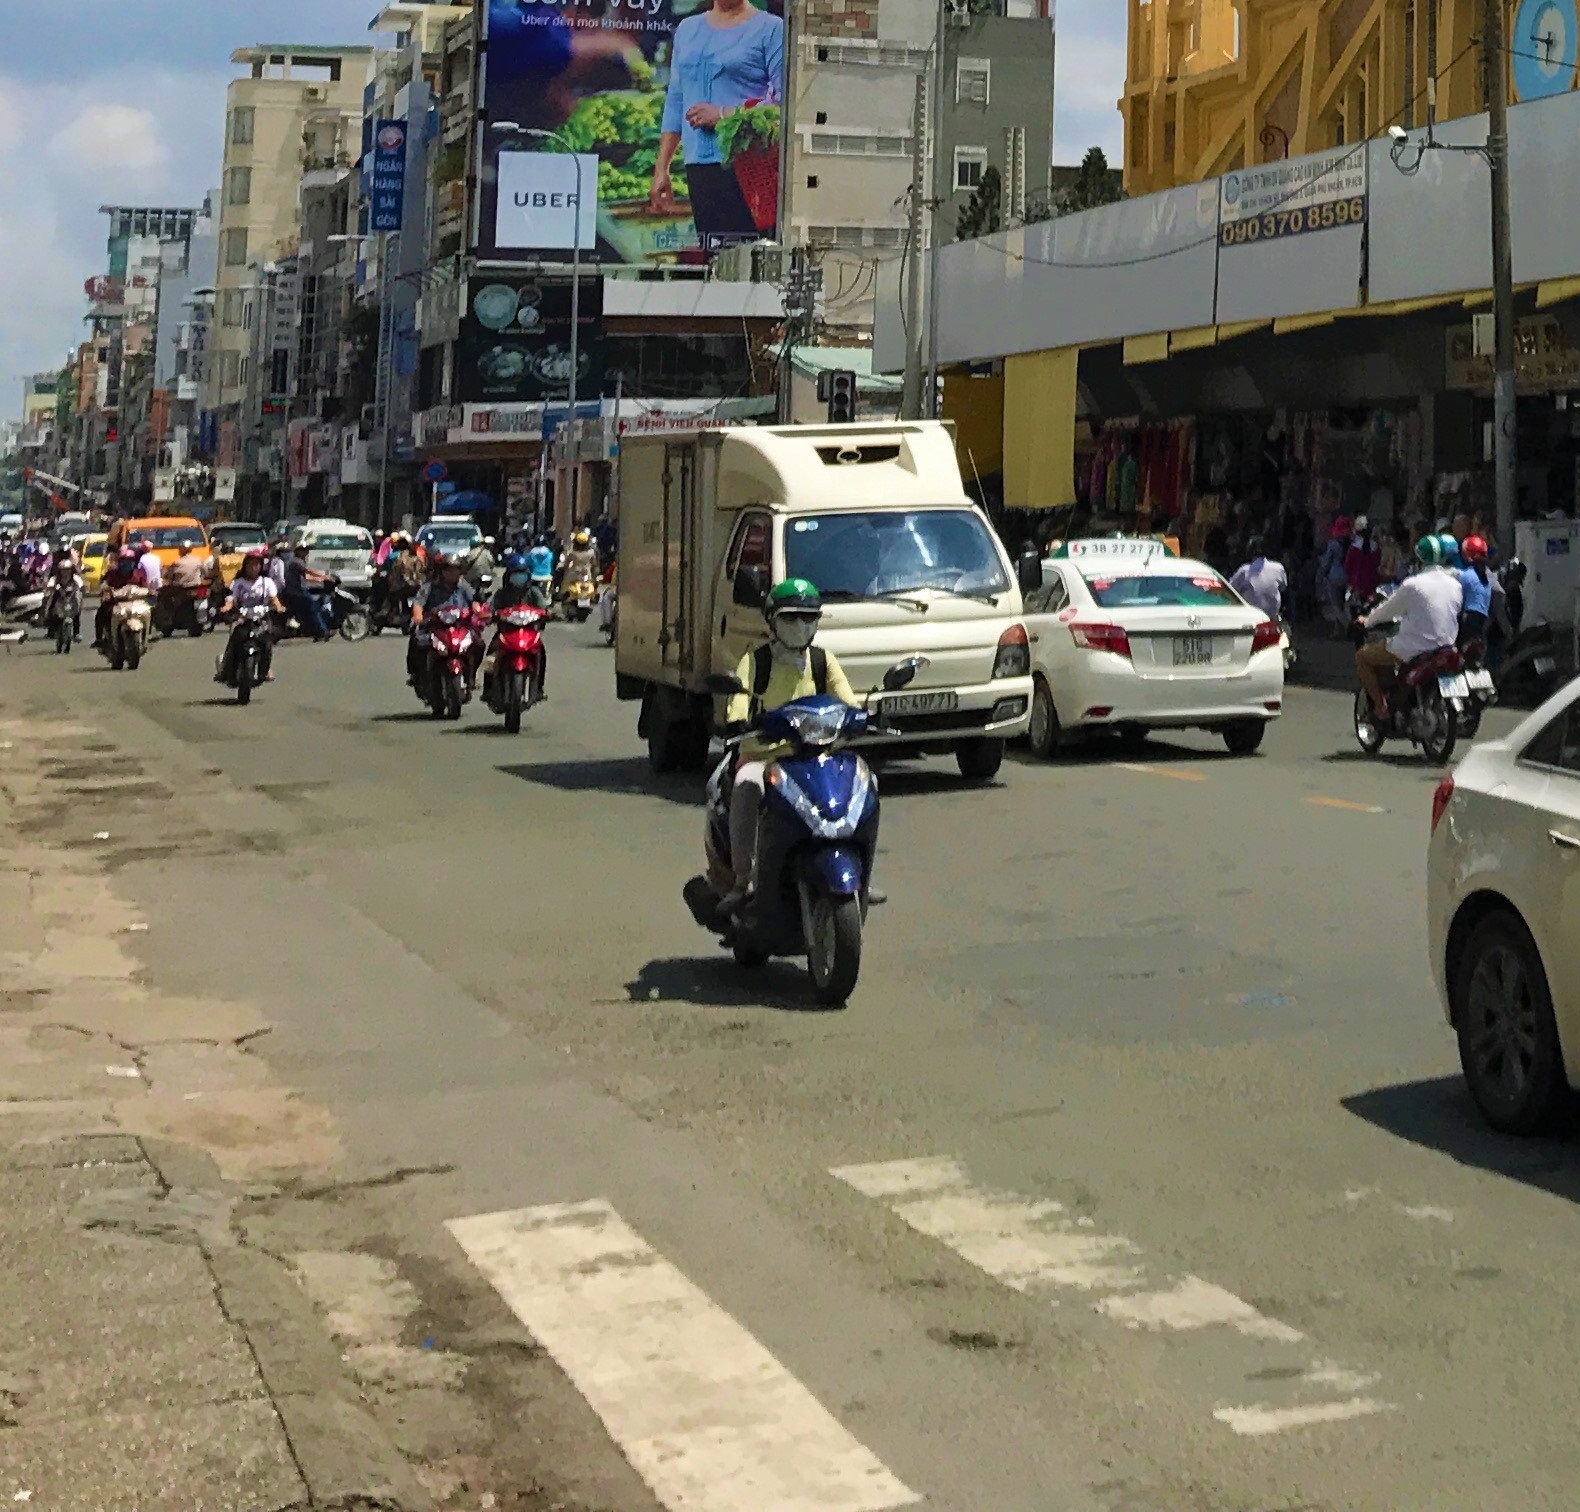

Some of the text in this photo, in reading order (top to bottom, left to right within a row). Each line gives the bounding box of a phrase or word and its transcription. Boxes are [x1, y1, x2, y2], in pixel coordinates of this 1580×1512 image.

[521, 14, 549, 26] Uber
[514, 191, 580, 208] UBER
[1223, 198, 1363, 246] 090 370 8596
[1112, 543, 1126, 554] 27
[1130, 543, 1144, 554] 27
